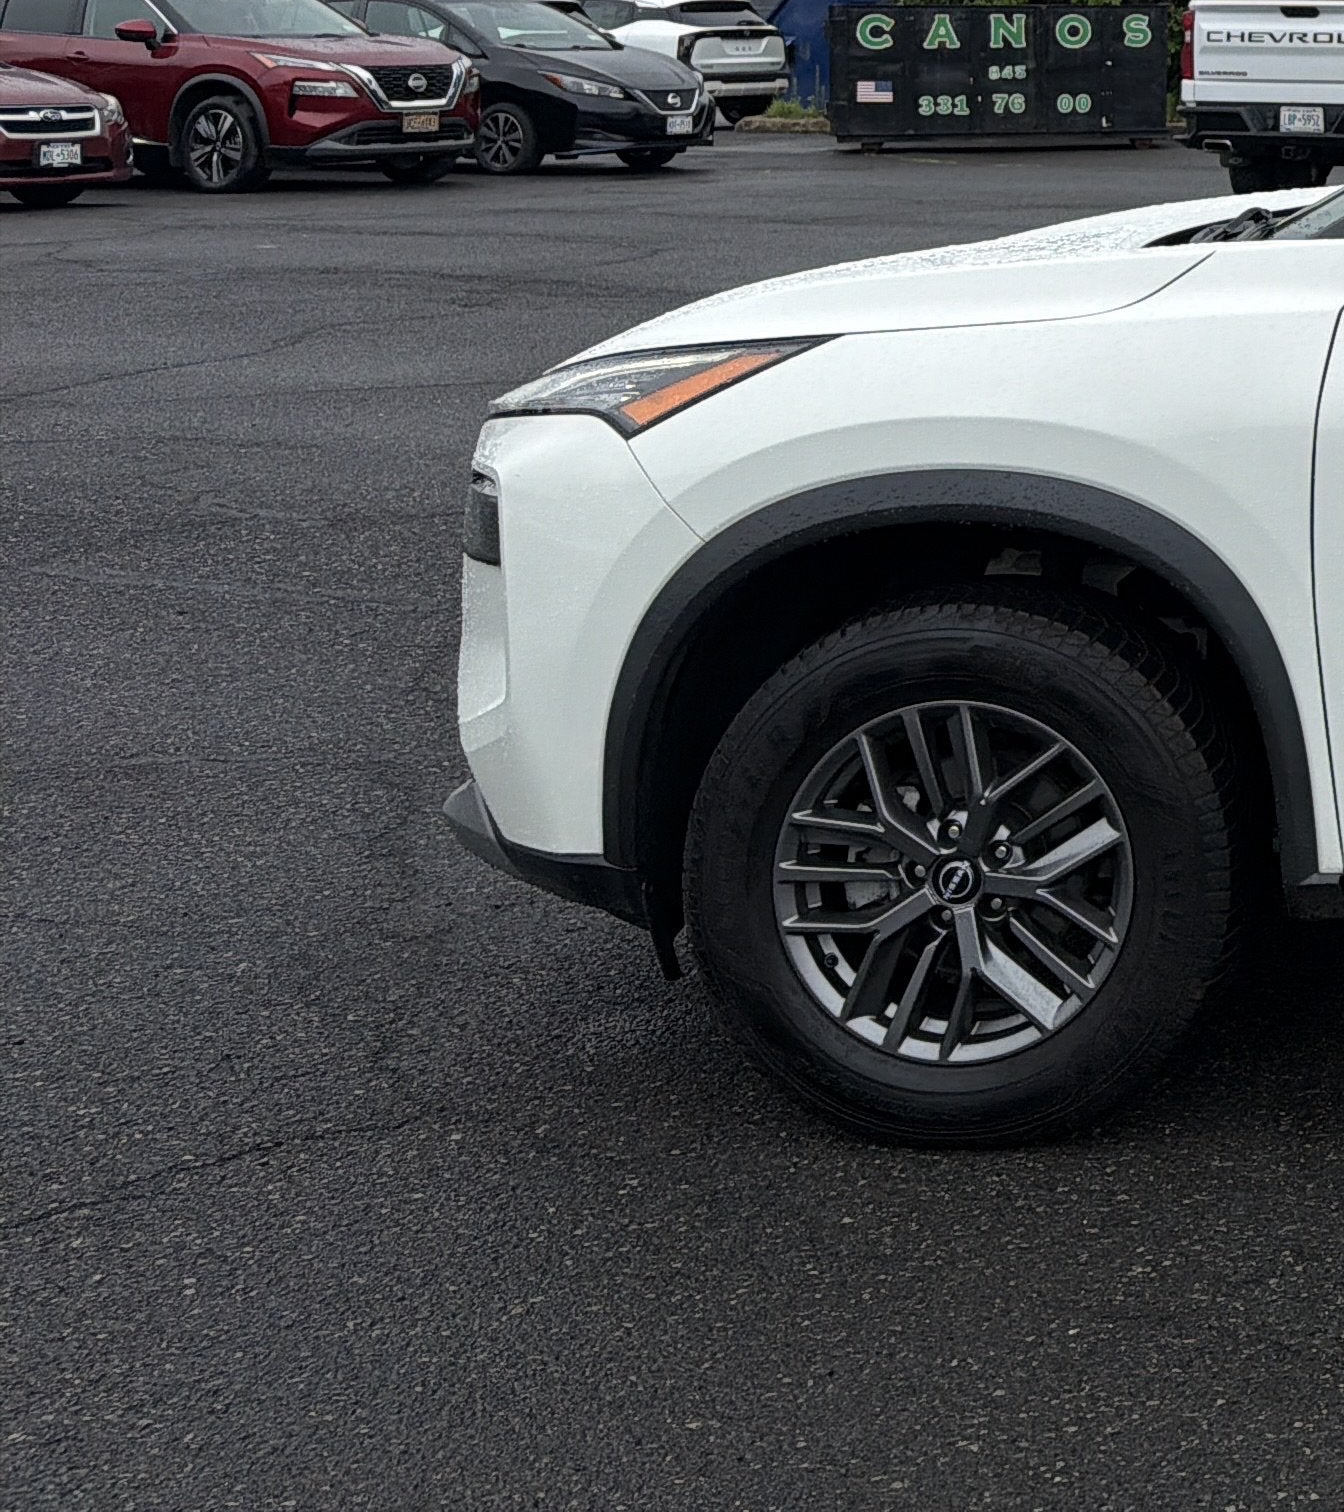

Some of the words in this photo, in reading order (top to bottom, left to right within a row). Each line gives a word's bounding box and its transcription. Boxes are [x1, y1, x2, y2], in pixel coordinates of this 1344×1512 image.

[918, 94, 971, 115] 331
[992, 93, 1026, 114] 76
[1057, 93, 1092, 114] 00
